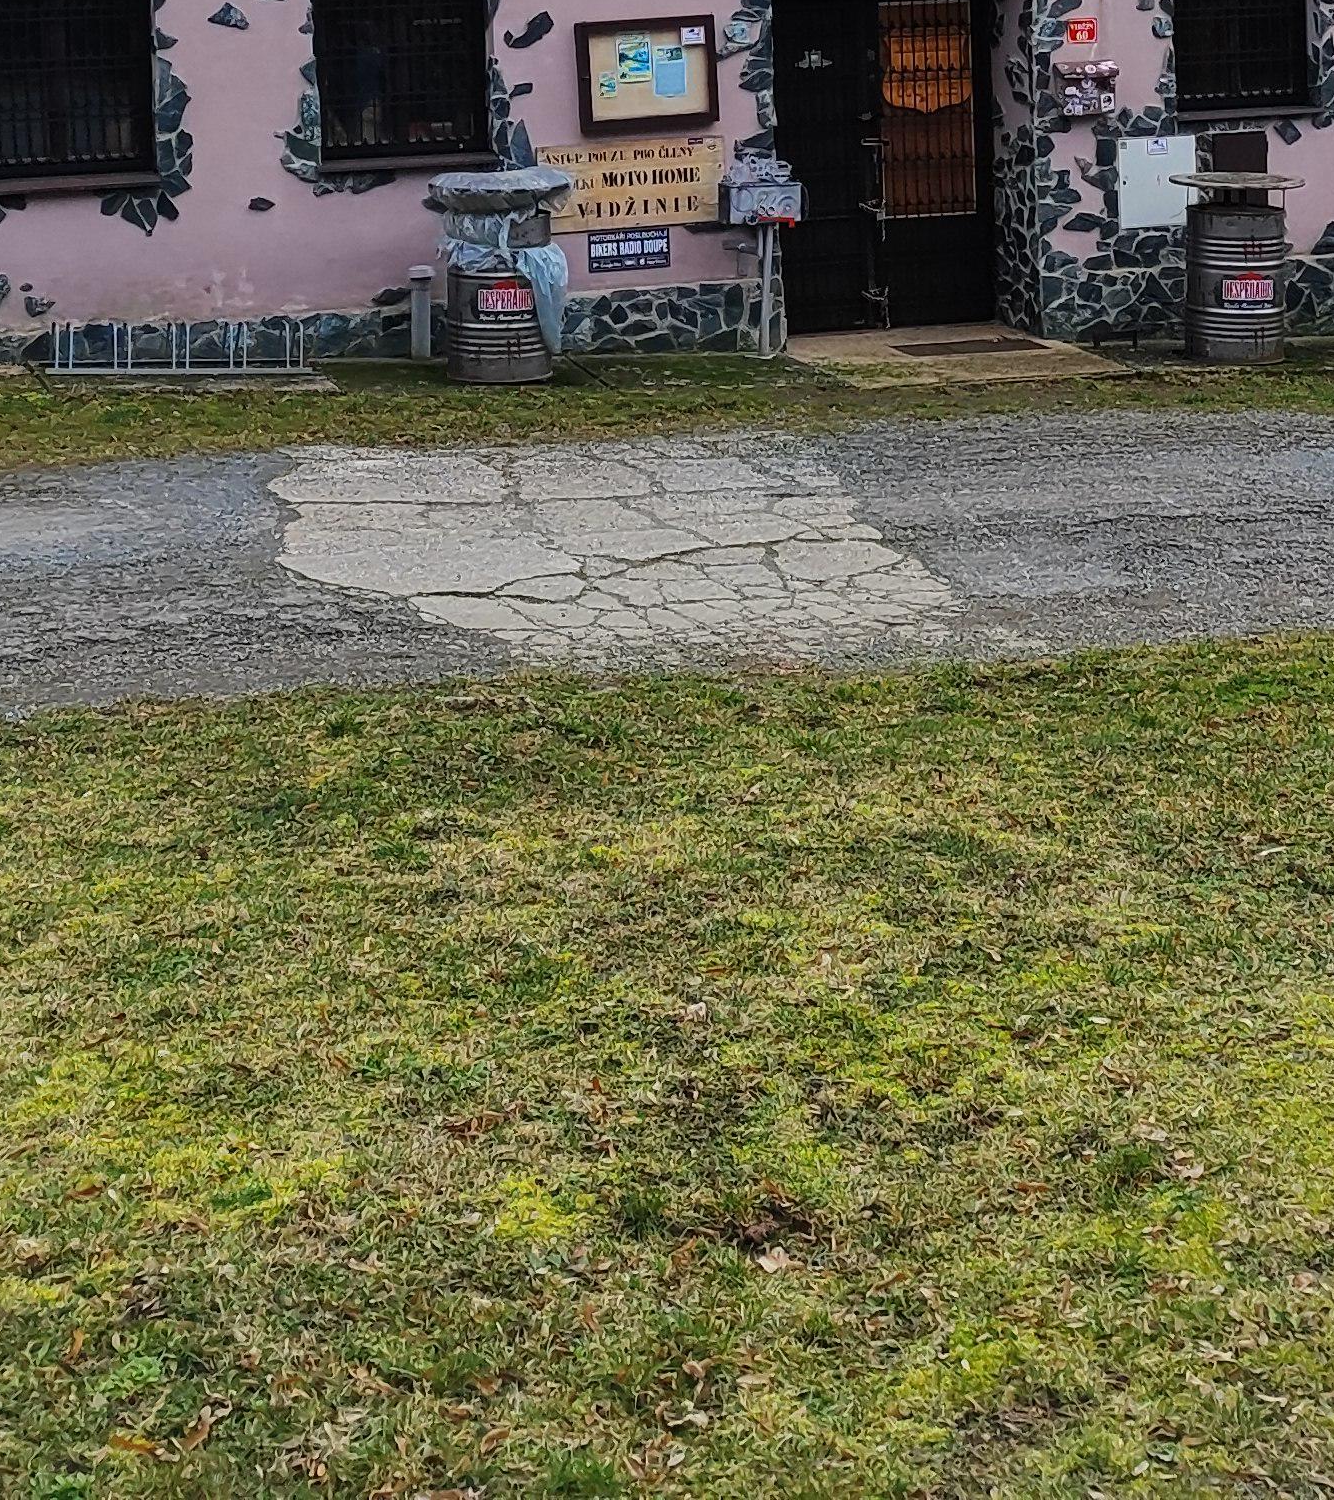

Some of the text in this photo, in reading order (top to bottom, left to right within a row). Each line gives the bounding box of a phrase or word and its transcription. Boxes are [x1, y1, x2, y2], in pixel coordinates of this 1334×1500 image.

[1075, 30, 1089, 41] 60
[633, 149, 655, 161] PRO
[601, 170, 648, 189] MOTO
[652, 167, 701, 185] HOME
[590, 242, 618, 258] BIKERS
[1223, 280, 1273, 299] DESPERADOS
